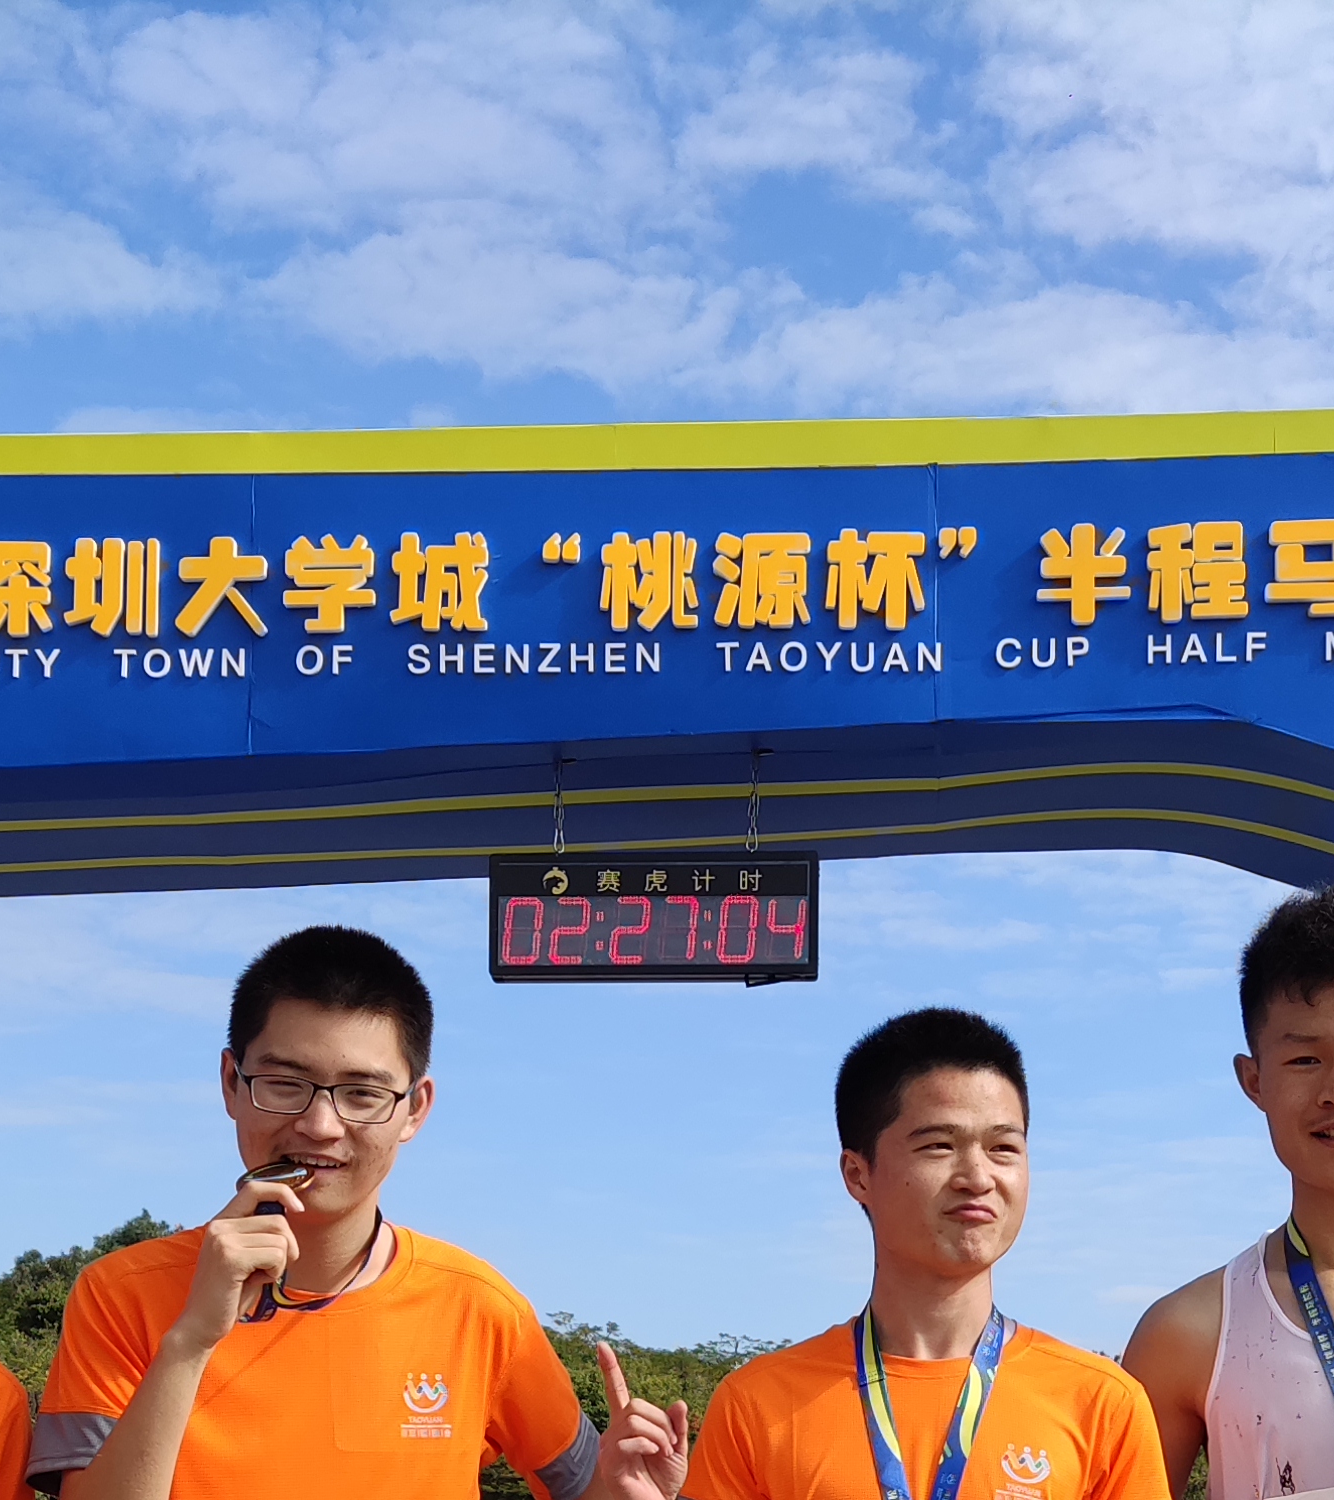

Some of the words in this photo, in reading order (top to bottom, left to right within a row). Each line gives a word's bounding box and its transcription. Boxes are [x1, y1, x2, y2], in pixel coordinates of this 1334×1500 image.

[114, 645, 248, 680] TOWN
[295, 644, 354, 677] OF
[406, 641, 663, 675] SHENZHEN
[716, 639, 945, 675] TAOYUAN
[995, 636, 1091, 670] CUP
[1146, 632, 1269, 666] HALF
[501, 893, 808, 966] 02:27:04
